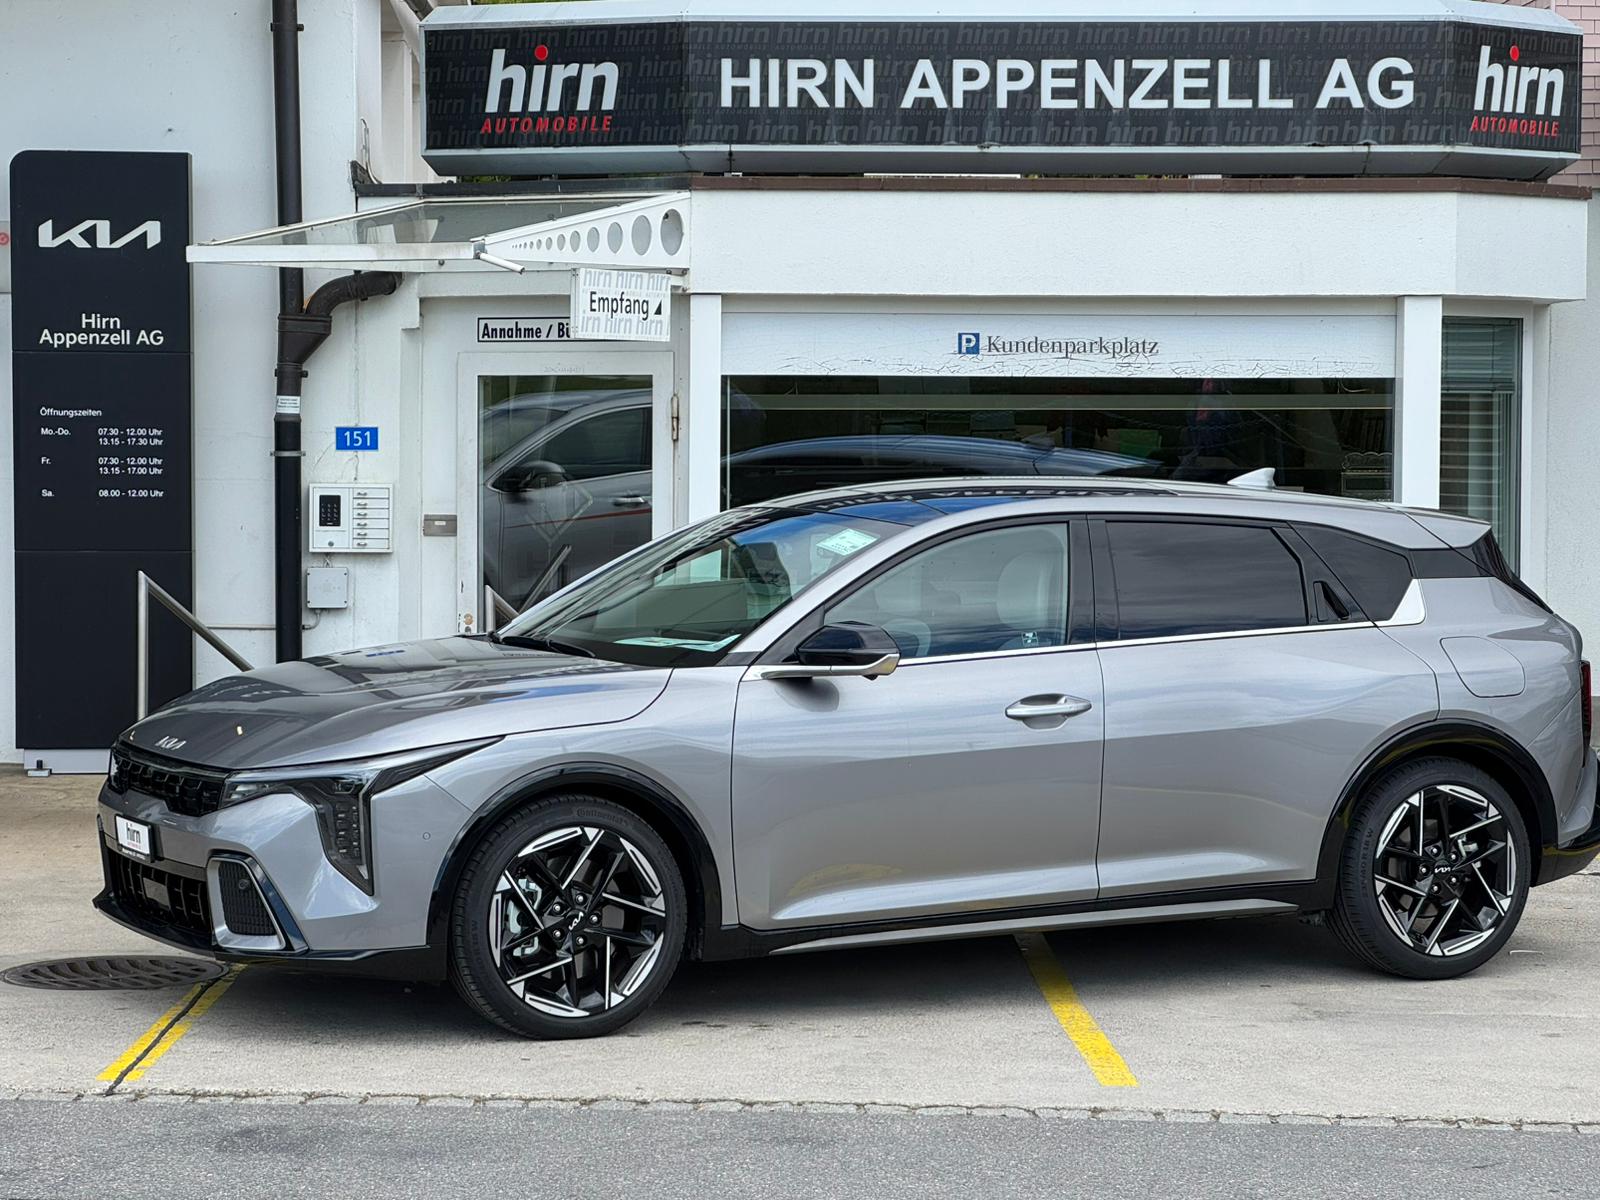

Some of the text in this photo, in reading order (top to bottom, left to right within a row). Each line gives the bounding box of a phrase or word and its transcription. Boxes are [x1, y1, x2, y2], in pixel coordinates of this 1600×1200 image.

[485, 45, 619, 113] hirn
[720, 57, 1414, 109] HIRN APPENZELL AG
[1474, 45, 1564, 116] hirn
[480, 115, 612, 134] AUTOMOBILE
[1470, 115, 1560, 139] AUTOMOBILE
[38, 219, 161, 249] KIA
[589, 291, 649, 321] Empfang
[81, 313, 121, 329] Hirn
[39, 329, 164, 348] Appenzell AG
[481, 322, 542, 339] Annahme
[546, 323, 553, 339] /
[987, 335, 1160, 358] Kundenparkplatz
[39, 406, 103, 418] Öffnungszeiten
[41, 427, 71, 436] Mo.-Do.
[98, 428, 119, 436] 07.30
[126, 428, 147, 436] 12.00
[148, 428, 163, 436] Uhr
[344, 431, 372, 447] 151
[99, 438, 120, 446] 13.15
[127, 438, 148, 446] 17.30
[149, 438, 164, 446] Uhr
[41, 457, 51, 465] Fr.
[98, 457, 119, 465] 07.30
[126, 457, 147, 465] 12.00
[148, 457, 163, 465] Uhr
[99, 467, 120, 475] 13.15
[127, 467, 147, 475] 17.00
[148, 467, 163, 475] Uhr
[41, 489, 55, 497] Sa.
[98, 489, 120, 497] 08.00
[127, 489, 148, 497] 12.00
[149, 489, 164, 497] Uhr
